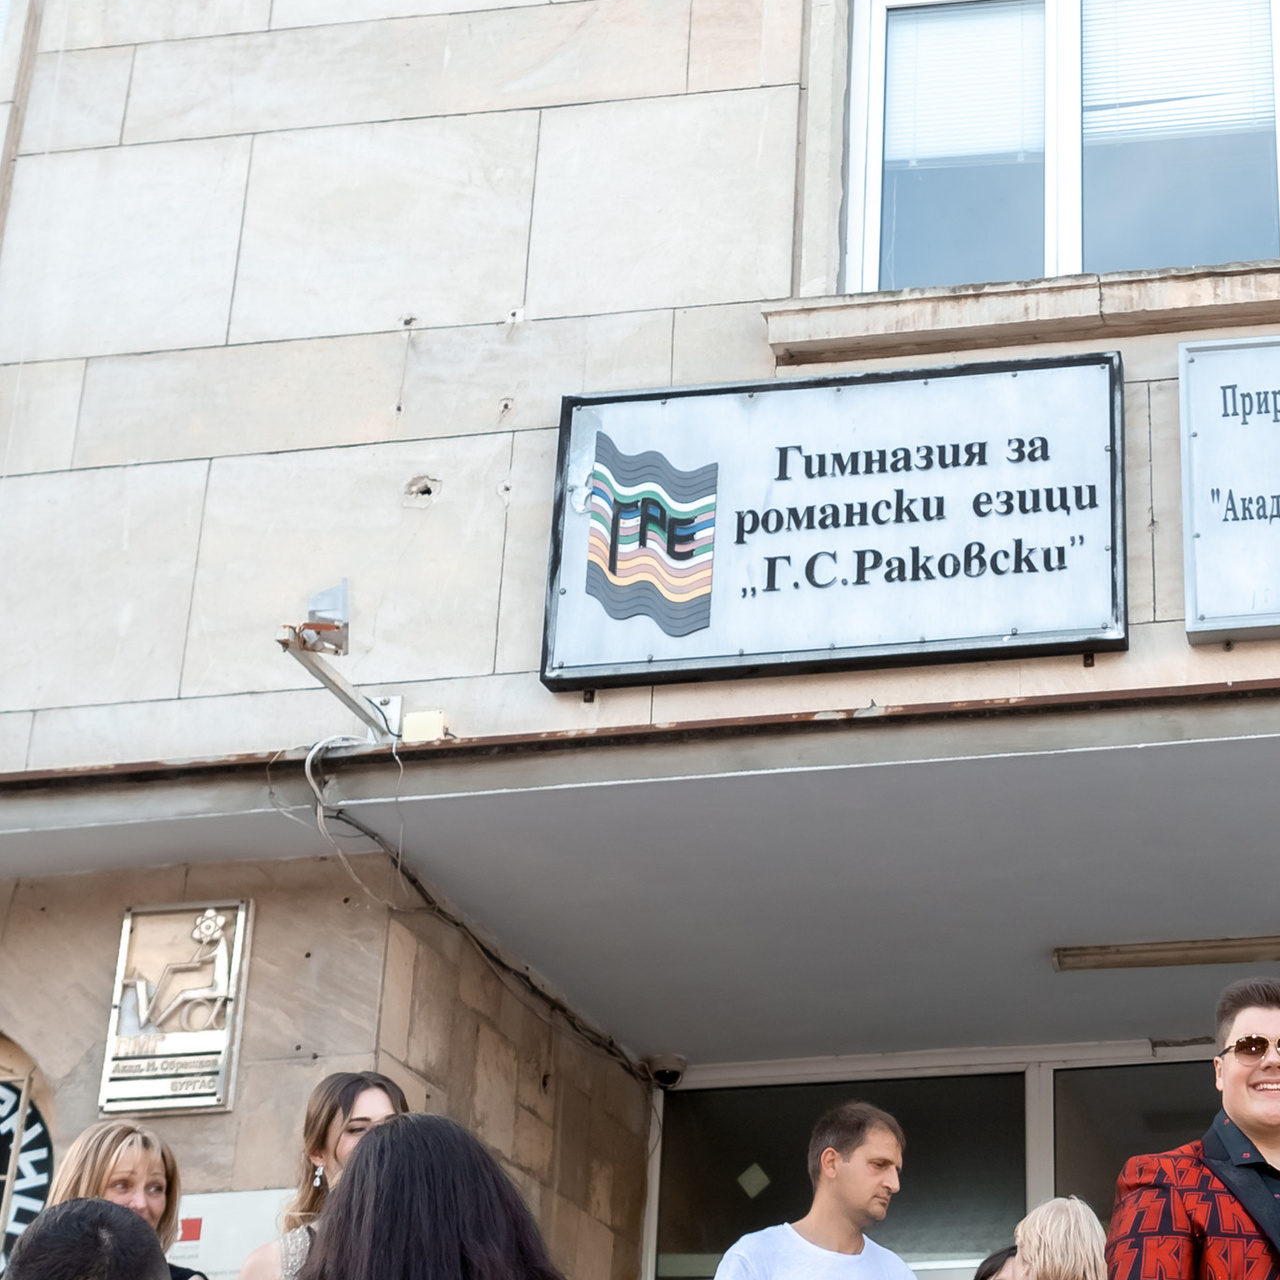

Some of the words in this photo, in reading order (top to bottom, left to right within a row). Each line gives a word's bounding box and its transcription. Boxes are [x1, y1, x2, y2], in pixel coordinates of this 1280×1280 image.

[774, 438, 988, 481] Гимназия
[1006, 437, 1050, 463] за
[735, 488, 946, 545] романски
[972, 483, 1100, 517] езици
[115, 1033, 166, 1057] ПМГ
[170, 1078, 216, 1092] БУРГАС
